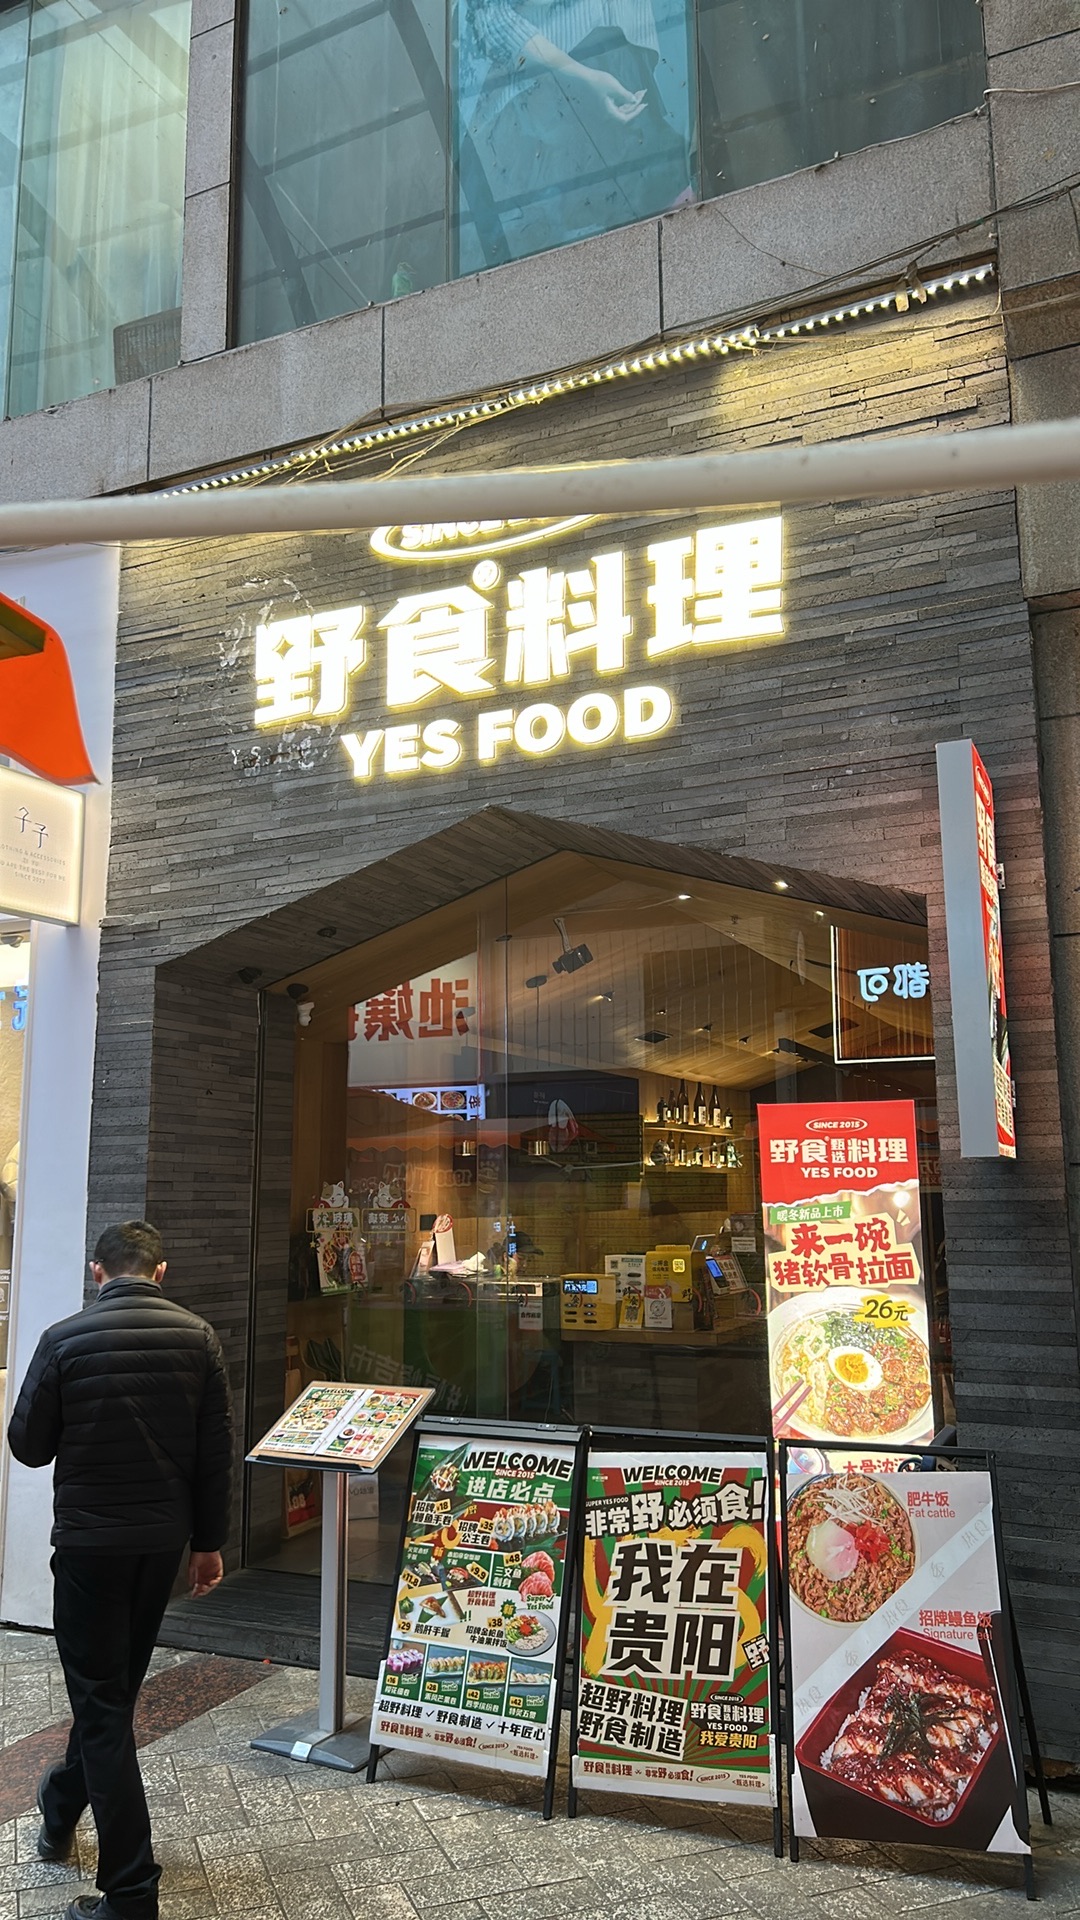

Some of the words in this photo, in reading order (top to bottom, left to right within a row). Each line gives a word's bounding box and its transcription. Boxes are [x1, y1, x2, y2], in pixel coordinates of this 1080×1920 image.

[254, 516, 785, 728] 野食料理
[341, 718, 462, 780] YES
[477, 685, 673, 762] FOOD
[0, 843, 23, 855] OTHING
[30, 851, 66, 866] ACCESSORIES
[15, 871, 31, 881] SINCE
[801, 1167, 830, 1178] YES
[833, 1167, 878, 1178] FOOD
[776, 1205, 844, 1221] 暖冬新品上市
[791, 1217, 892, 1260] 来一碗
[773, 1251, 915, 1287] 猪软骨拉面
[864, 1299, 909, 1322] 26元
[463, 1451, 574, 1480] WELCOME
[495, 1468, 517, 1477] SINCE
[517, 1471, 536, 1479] 2015
[843, 1458, 907, 1473] 大骨浓
[622, 1465, 724, 1483] WELCOME
[466, 1475, 556, 1502] 进店必点
[585, 1499, 602, 1508] SUPER
[602, 1498, 613, 1506] YES
[613, 1496, 629, 1504] FOOD
[906, 1491, 950, 1507] 肥牛饭
[415, 1501, 436, 1514] 招牌
[908, 1508, 925, 1518] Fat
[927, 1508, 956, 1518] cattle
[458, 1520, 479, 1533] 招牌
[461, 1533, 491, 1546] 公主卷
[494, 1566, 523, 1579] 三文鱼
[611, 1542, 740, 1606] 我在
[526, 1594, 546, 1603] Super
[527, 1603, 538, 1611] Yes
[538, 1602, 554, 1610] Food
[919, 1609, 993, 1629] 招牌鳗鱼饭
[923, 1627, 974, 1641] Signature
[607, 1609, 736, 1676] 贵阳
[579, 1681, 684, 1728] 超野料理
[377, 1699, 423, 1719] 超野料理
[436, 1710, 482, 1730] 野食制造
[498, 1722, 546, 1741] 十年匠心
[706, 1722, 723, 1731] YES
[724, 1723, 748, 1732] FOOD
[579, 1711, 683, 1757] 野食制造
[700, 1730, 758, 1749] 我爱贵阳
[700, 1775, 713, 1783] SINCE
